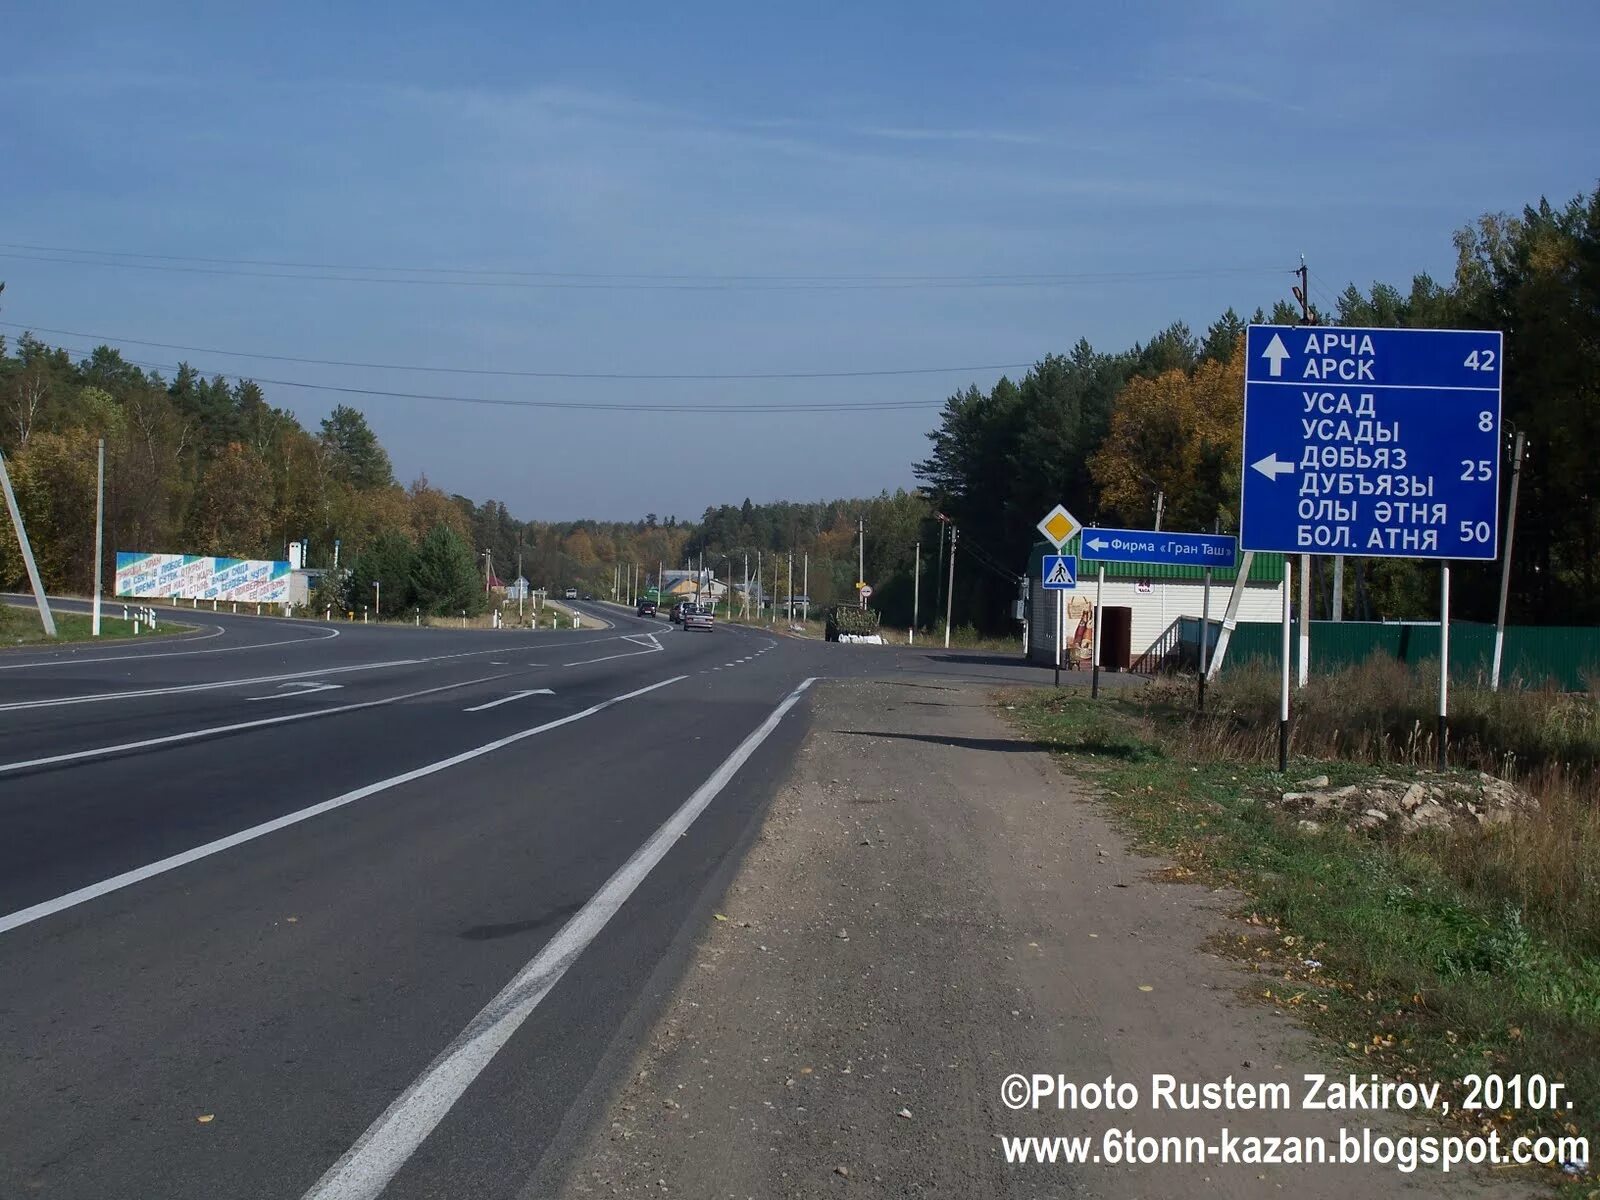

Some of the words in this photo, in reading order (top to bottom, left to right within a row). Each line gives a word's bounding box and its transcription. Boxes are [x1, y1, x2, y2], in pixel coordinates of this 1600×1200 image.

[1304, 334, 1375, 355] АРЧА
[1303, 359, 1374, 380] АРСК
[1464, 350, 1495, 370] 42
[1302, 392, 1375, 420] УСАД
[1302, 419, 1398, 445] УСАДЫ
[1479, 411, 1493, 432] 8
[1300, 446, 1406, 470] ДӨБЬЯЗ
[1461, 460, 1492, 481] 25
[1300, 473, 1433, 497] ДУБЪЯЗЫ
[1299, 499, 1356, 521] ОЛЫ
[1375, 502, 1446, 524] ӘТНЯ
[1298, 525, 1356, 547] БОЛ.
[1367, 528, 1437, 550] АТНЯ
[1460, 521, 1490, 542] 50
[1111, 539, 1154, 553] Фирма
[1160, 542, 1197, 555] «Гран
[1202, 544, 1231, 555] Таш»
